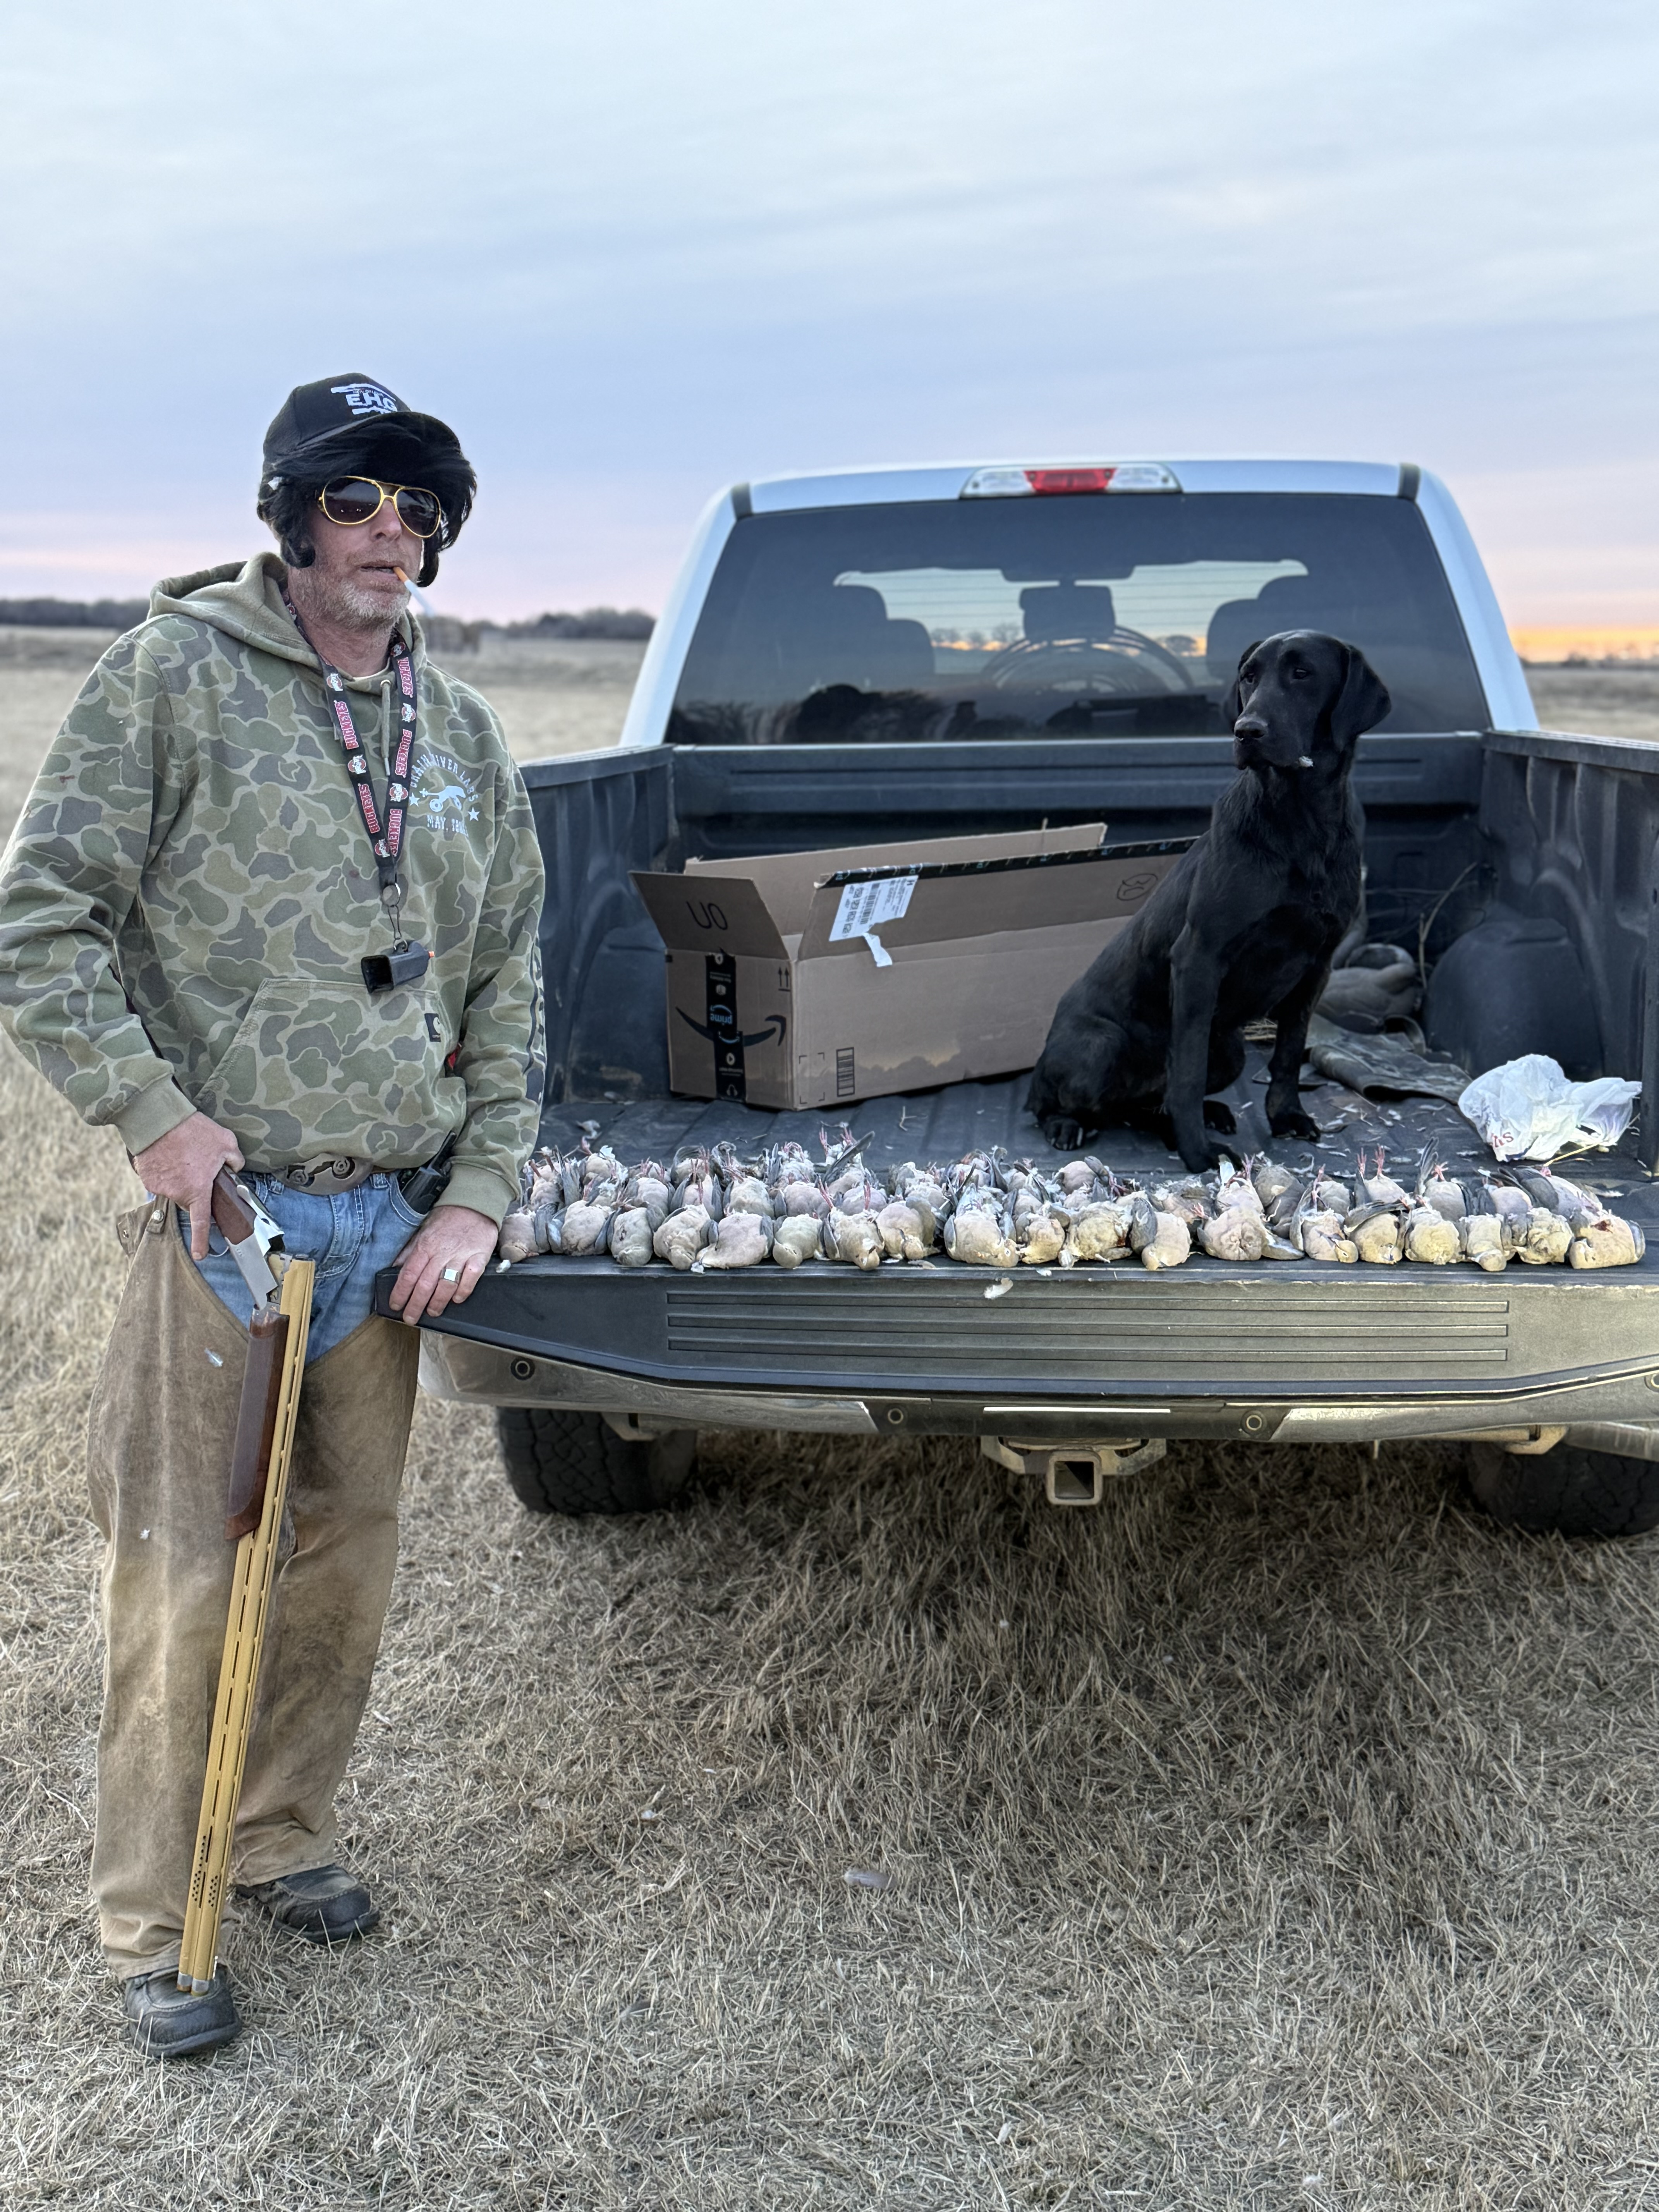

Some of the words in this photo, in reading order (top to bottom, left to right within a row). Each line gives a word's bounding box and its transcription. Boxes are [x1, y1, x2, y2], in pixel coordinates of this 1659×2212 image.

[397, 657, 413, 698] UCKEYES
[334, 700, 359, 750] BUCKEYES
[395, 728, 412, 776] BUCKEYES
[357, 783, 380, 834] BUCKEYES
[388, 808, 403, 855] BUCKEYES
[710, 1013, 732, 1025] prime
